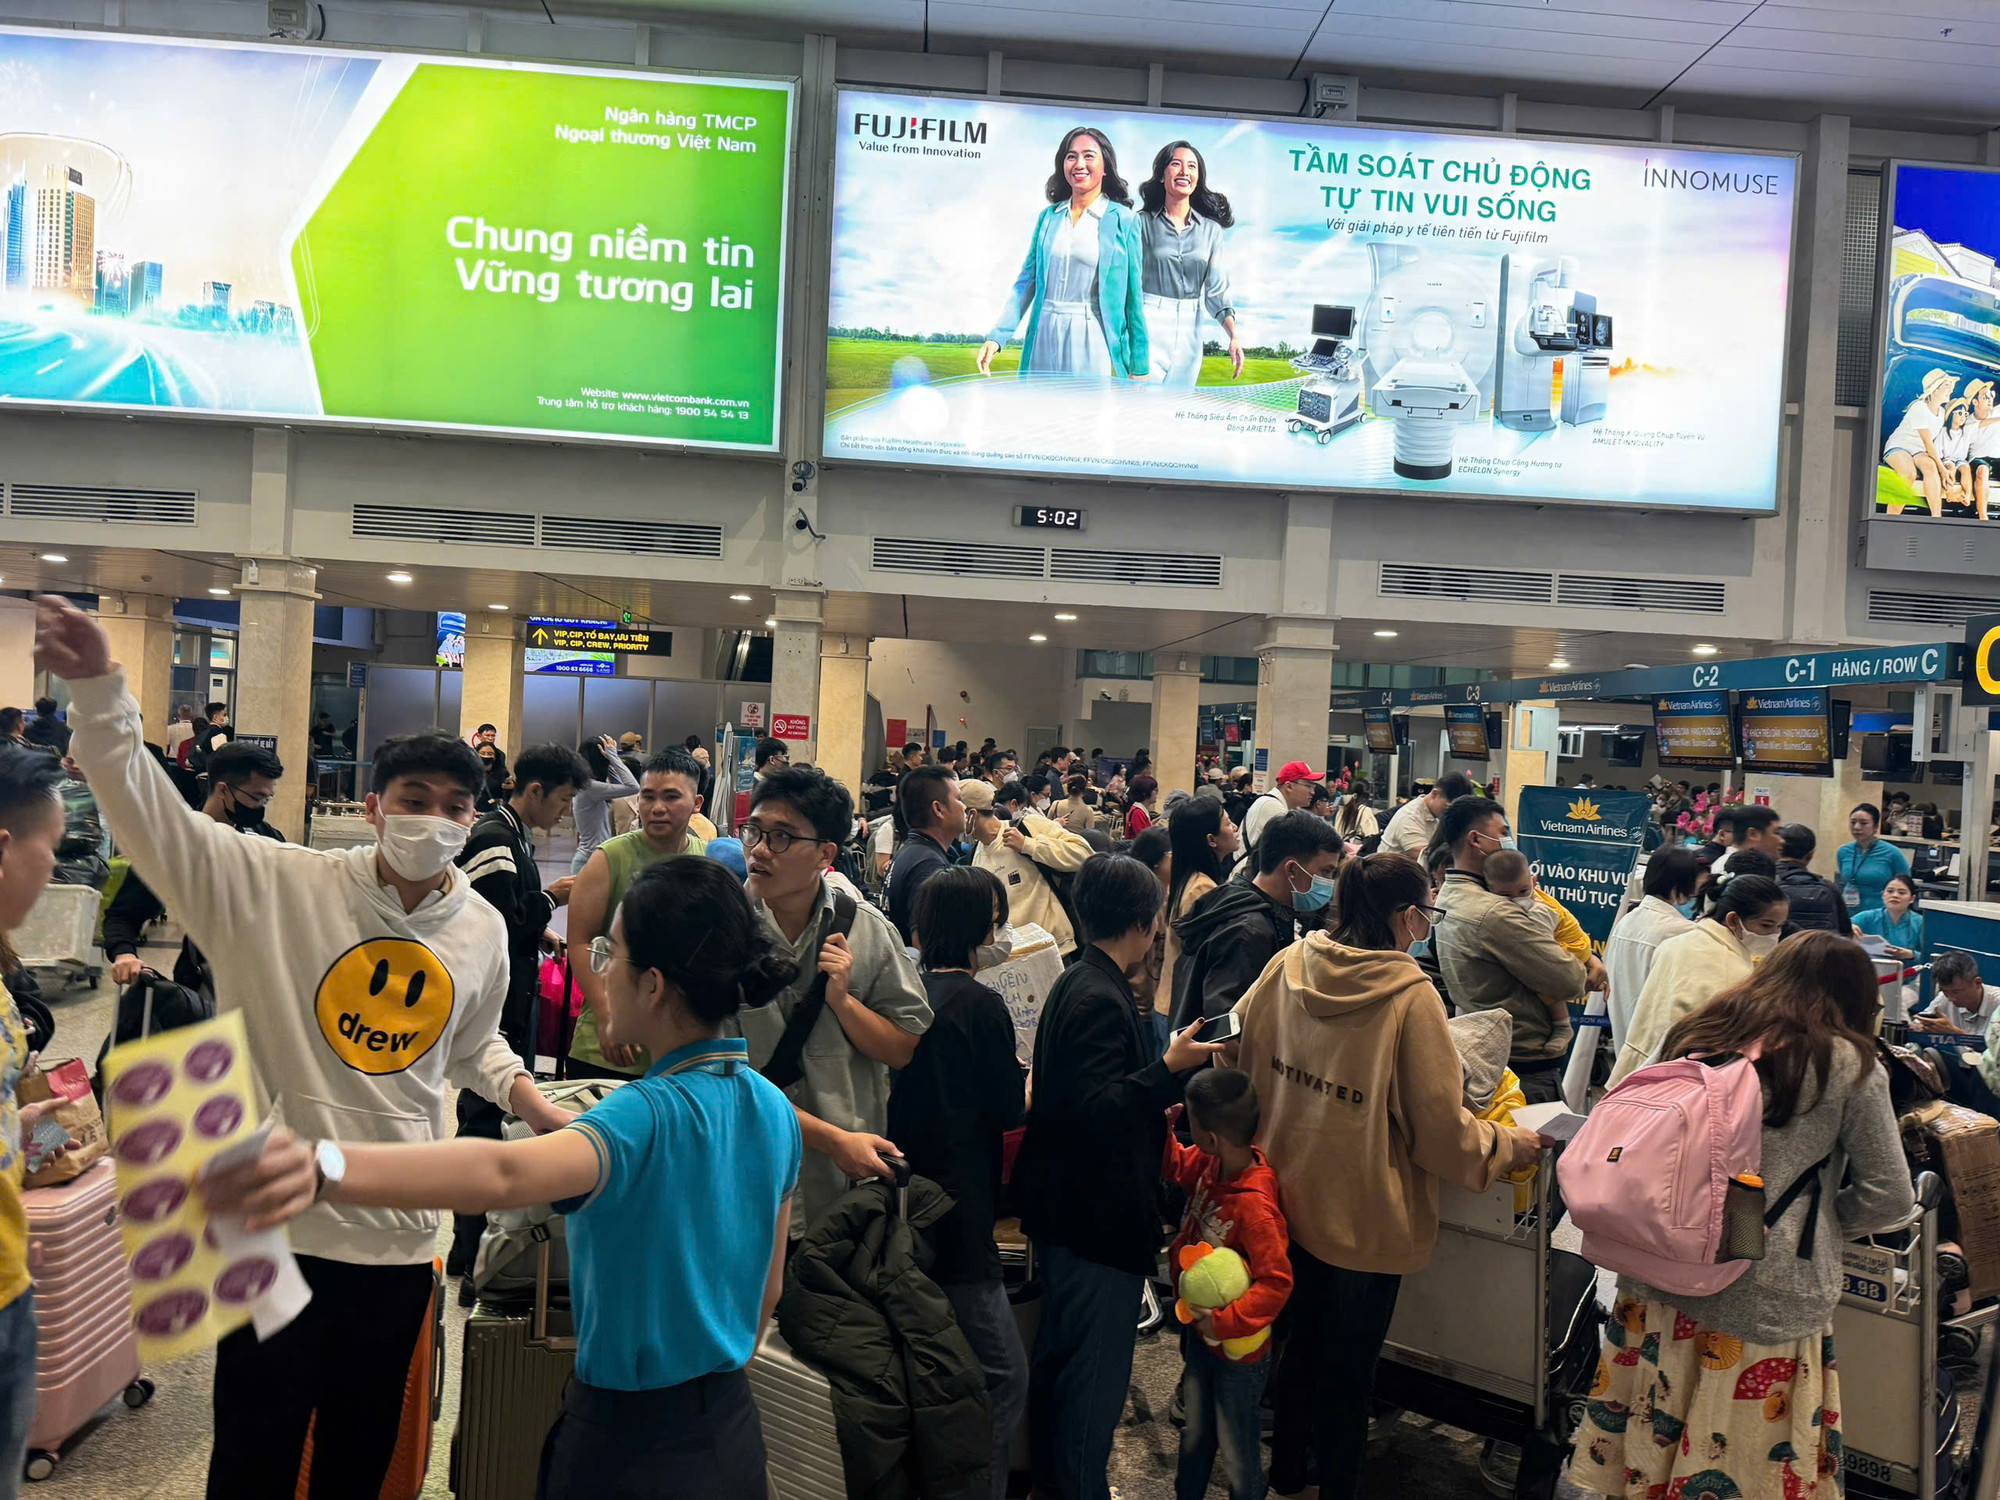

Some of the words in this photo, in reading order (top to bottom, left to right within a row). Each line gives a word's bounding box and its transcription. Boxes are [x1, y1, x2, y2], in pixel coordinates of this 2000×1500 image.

[605, 106, 649, 126] Ngân
[656, 110, 697, 130] hàng
[703, 114, 757, 131] TMCP
[854, 113, 987, 144] FUJIFILM
[555, 124, 604, 144] Ngoại
[610, 129, 671, 149] thương
[678, 133, 711, 151] Việt
[718, 137, 756, 153] Nam
[859, 141, 889, 152] Value
[893, 144, 919, 154] from
[923, 146, 981, 159] Innovation
[1289, 143, 1348, 174] TẦM
[1358, 152, 1434, 181] SOÁT
[1442, 157, 1501, 185] CHỦ
[1510, 160, 1591, 193] ĐỘNG
[1320, 186, 1362, 214] TỰ
[1370, 189, 1413, 213] TIN
[1424, 192, 1467, 217] VUI
[1477, 190, 1556, 222] SỐNG
[446, 216, 573, 262] Chung
[590, 222, 687, 263] niềm
[703, 236, 754, 268] tin
[1326, 218, 1345, 230] Với
[1348, 220, 1370, 234] giải
[1372, 221, 1403, 236] pháp
[1407, 227, 1414, 237] y
[1416, 222, 1432, 236] tế
[1432, 224, 1455, 237] tiên
[1460, 225, 1482, 239] tiến
[1485, 228, 1500, 240] từ
[1502, 230, 1548, 244] Fujifilm
[454, 258, 560, 303] Vững
[576, 270, 693, 312] tương
[710, 276, 753, 310] lai
[537, 396, 562, 408] Trung
[566, 399, 583, 408] tâm
[602, 402, 615, 411] trợ
[618, 401, 644, 413] khách
[648, 404, 672, 416] hàng:
[675, 406, 700, 416] 1900
[704, 408, 718, 417] 54
[721, 410, 734, 419] 54
[738, 411, 749, 420] 13
[581, 387, 619, 399] Website:
[622, 392, 749, 408] www.vietcombank.com.vn
[1246, 425, 1276, 433] ARIETTA
[1458, 466, 1492, 474] ECHELON
[1494, 468, 1521, 477] Synergy
[1037, 510, 1077, 526] 5:02
[572, 640, 585, 648] CIP,
[586, 641, 612, 650] CREW,
[614, 642, 648, 651] PRIORITY
[631, 634, 649, 643] TIÊN
[1785, 658, 1816, 683] C-1
[1831, 658, 1870, 678] HÀNG
[1882, 656, 1919, 674] ROW
[1921, 648, 1939, 675] C
[1692, 665, 1718, 688] C-2
[1382, 692, 1392, 705] C-4
[1466, 686, 1481, 701] C-3
[1540, 820, 1586, 834] Vietnam
[1586, 824, 1627, 838] Airlines
[1529, 860, 1544, 877] ỐI
[1547, 863, 1575, 880] VÀO
[1578, 868, 1608, 883] KHU
[1558, 886, 1587, 903] THỦ
[1589, 891, 1618, 909] TỤC
[338, 1012, 419, 1052] drew
[1928, 1034, 1956, 1045] TIA
[1271, 1056, 1363, 1104] MOTIVATED
[1843, 1276, 1880, 1299] 8.98
[1845, 1454, 1890, 1481] 9898
